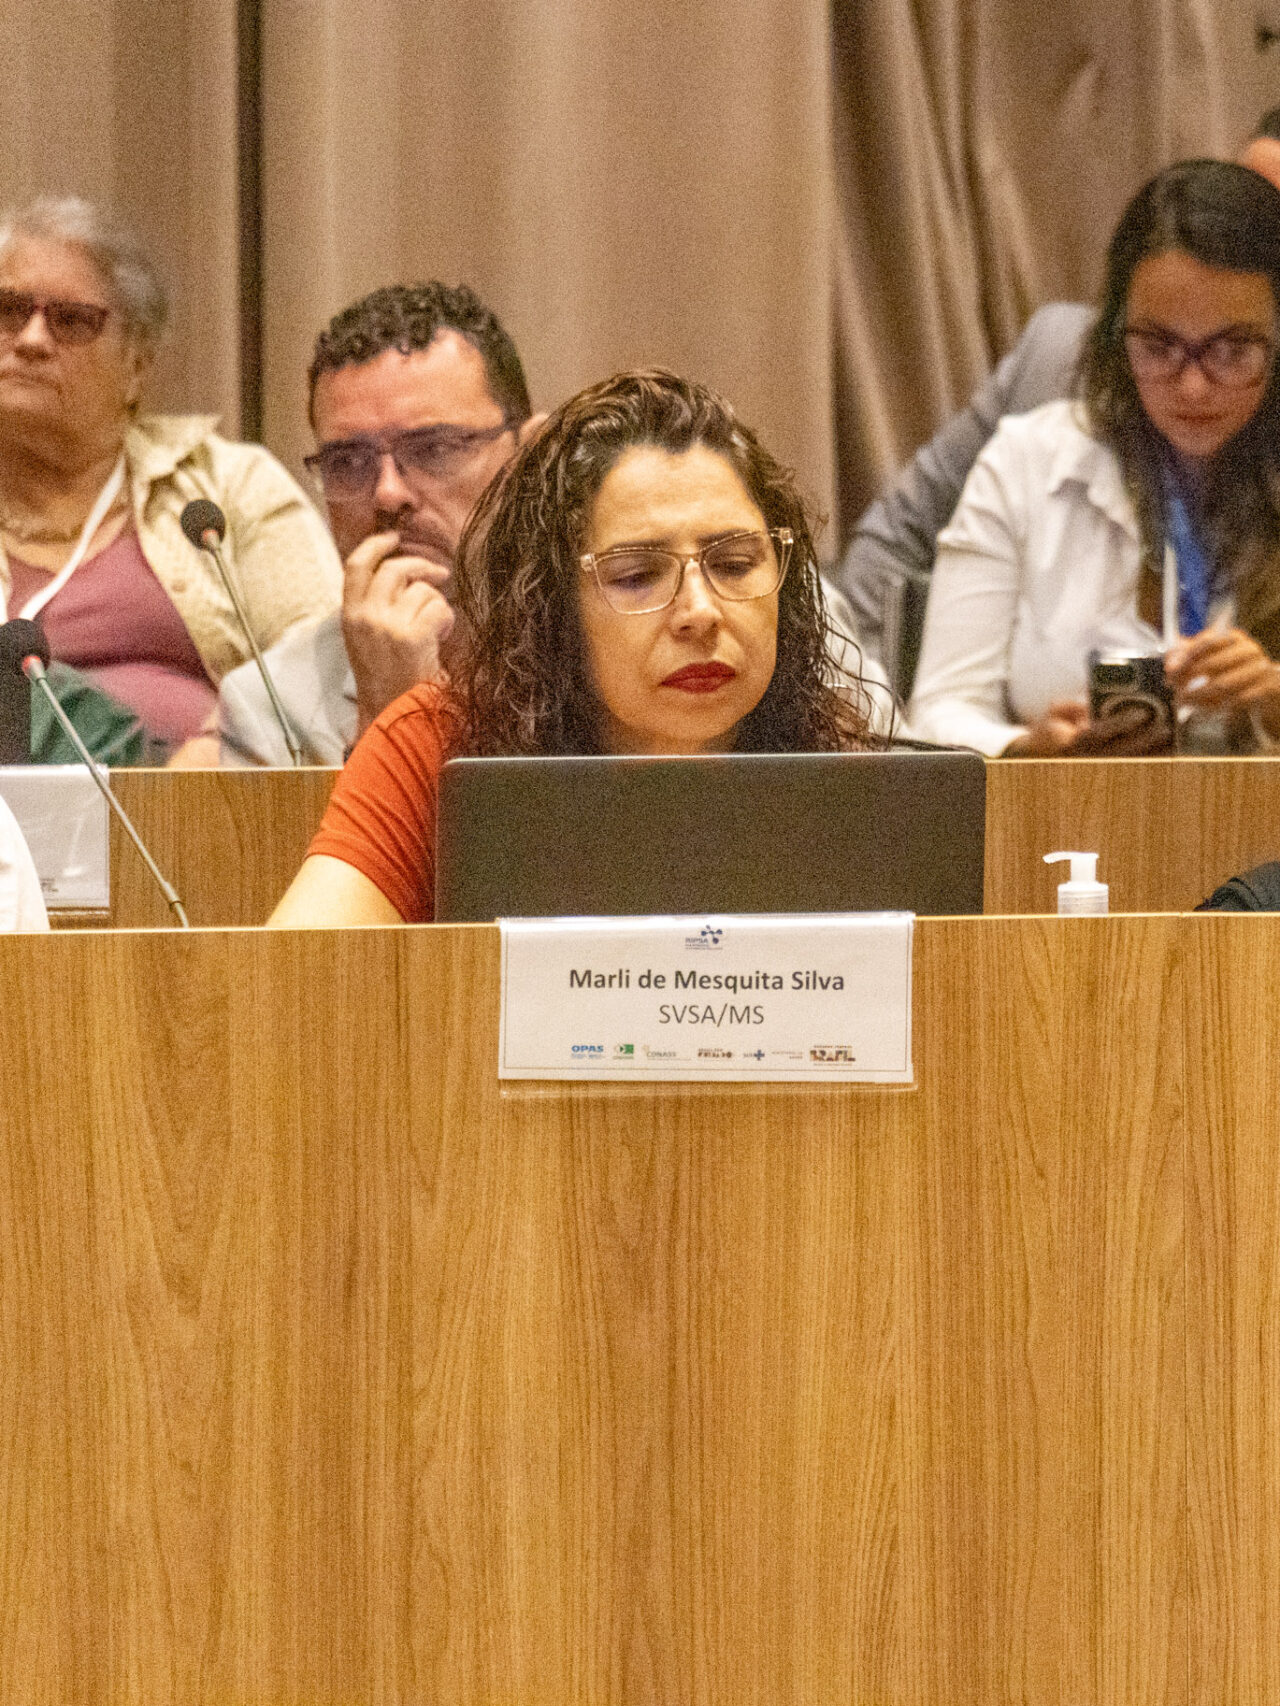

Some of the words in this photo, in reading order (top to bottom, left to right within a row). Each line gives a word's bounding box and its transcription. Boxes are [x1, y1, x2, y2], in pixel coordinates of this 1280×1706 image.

[569, 968, 630, 989] Marli
[637, 968, 667, 990] de
[674, 969, 784, 995] Mesquita
[791, 970, 845, 991] Silva
[658, 1003, 765, 1027] SVSA/MS
[571, 1045, 604, 1053] OPAS
